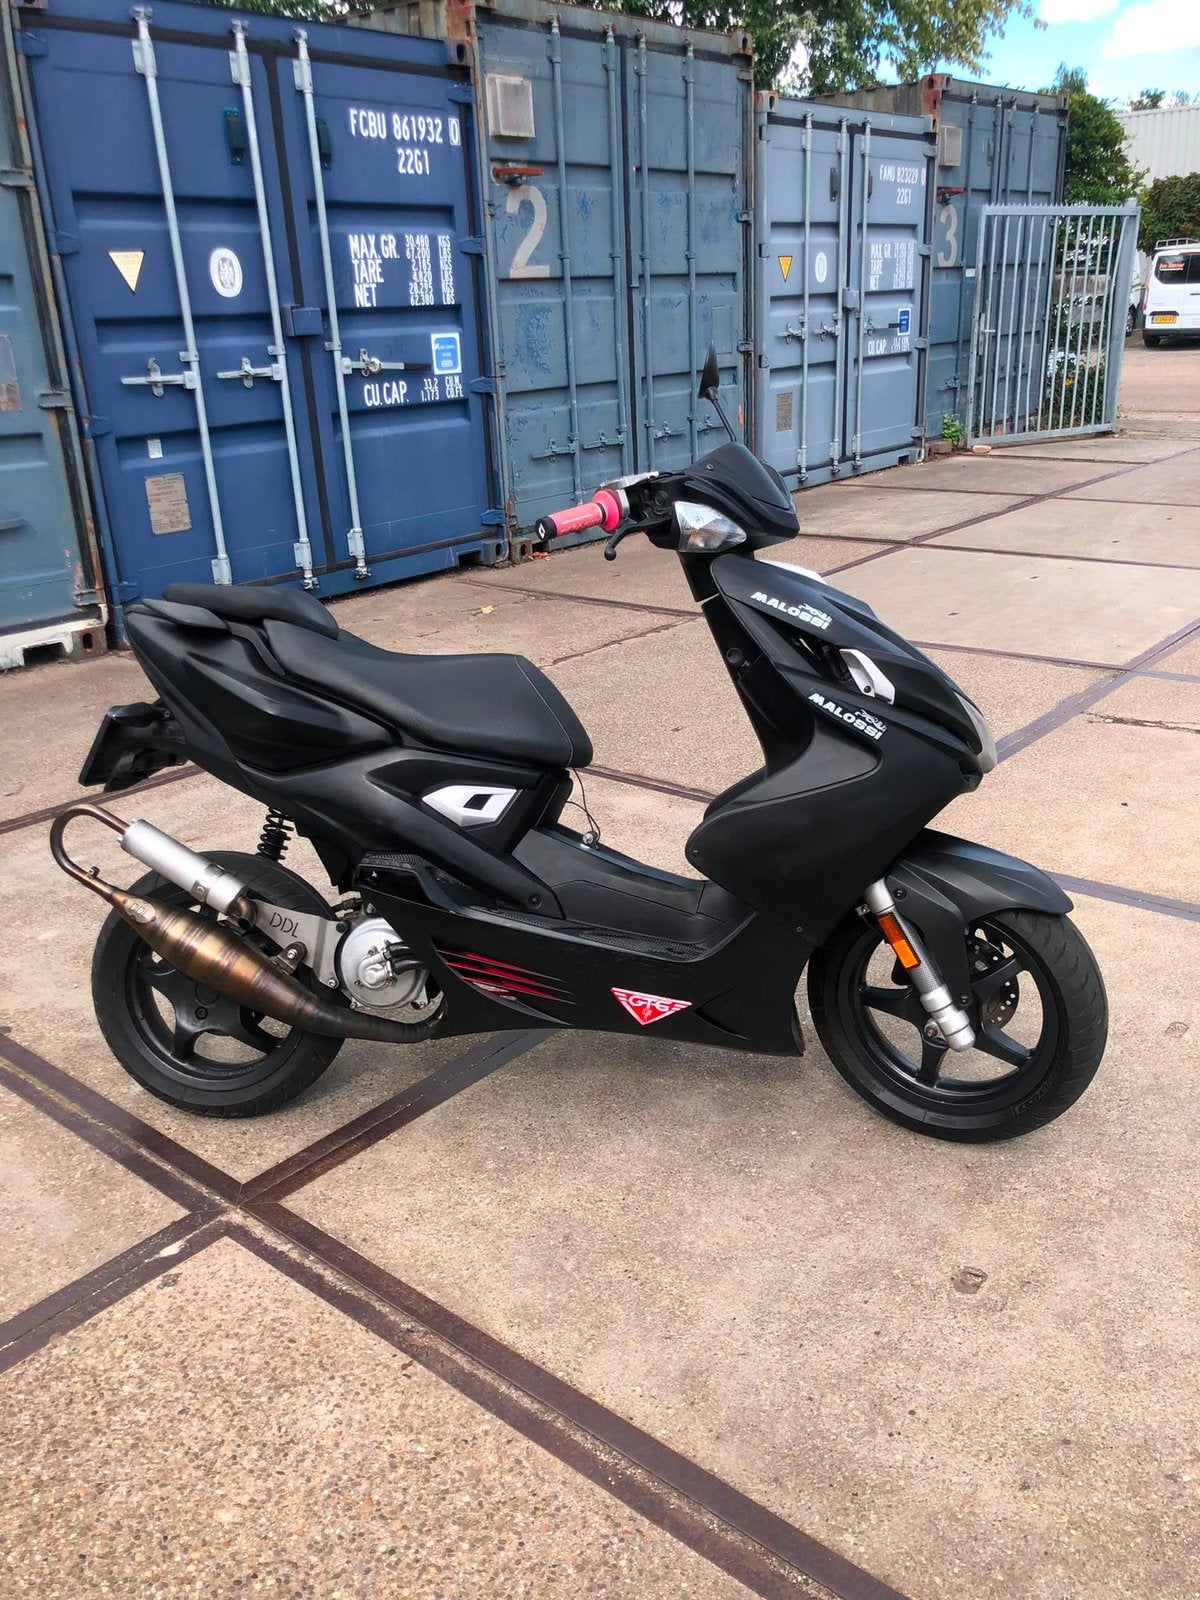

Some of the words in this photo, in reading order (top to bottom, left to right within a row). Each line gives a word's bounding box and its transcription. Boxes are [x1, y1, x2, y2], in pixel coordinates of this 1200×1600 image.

[349, 107, 387, 139] FCBU
[392, 111, 443, 144] 861932
[397, 147, 430, 176] 22G1
[879, 164, 895, 182] FAMU
[896, 188, 912, 205] 22G1
[506, 185, 549, 278] 2
[937, 203, 958, 268] 3
[406, 246, 431, 260] 67.200
[352, 259, 385, 284] TARE
[354, 283, 377, 308] NET
[750, 591, 830, 630] MALOSSI
[808, 692, 885, 741] MALOSSI
[130, 902, 150, 919] DDL
[269, 911, 299, 939] DDL
